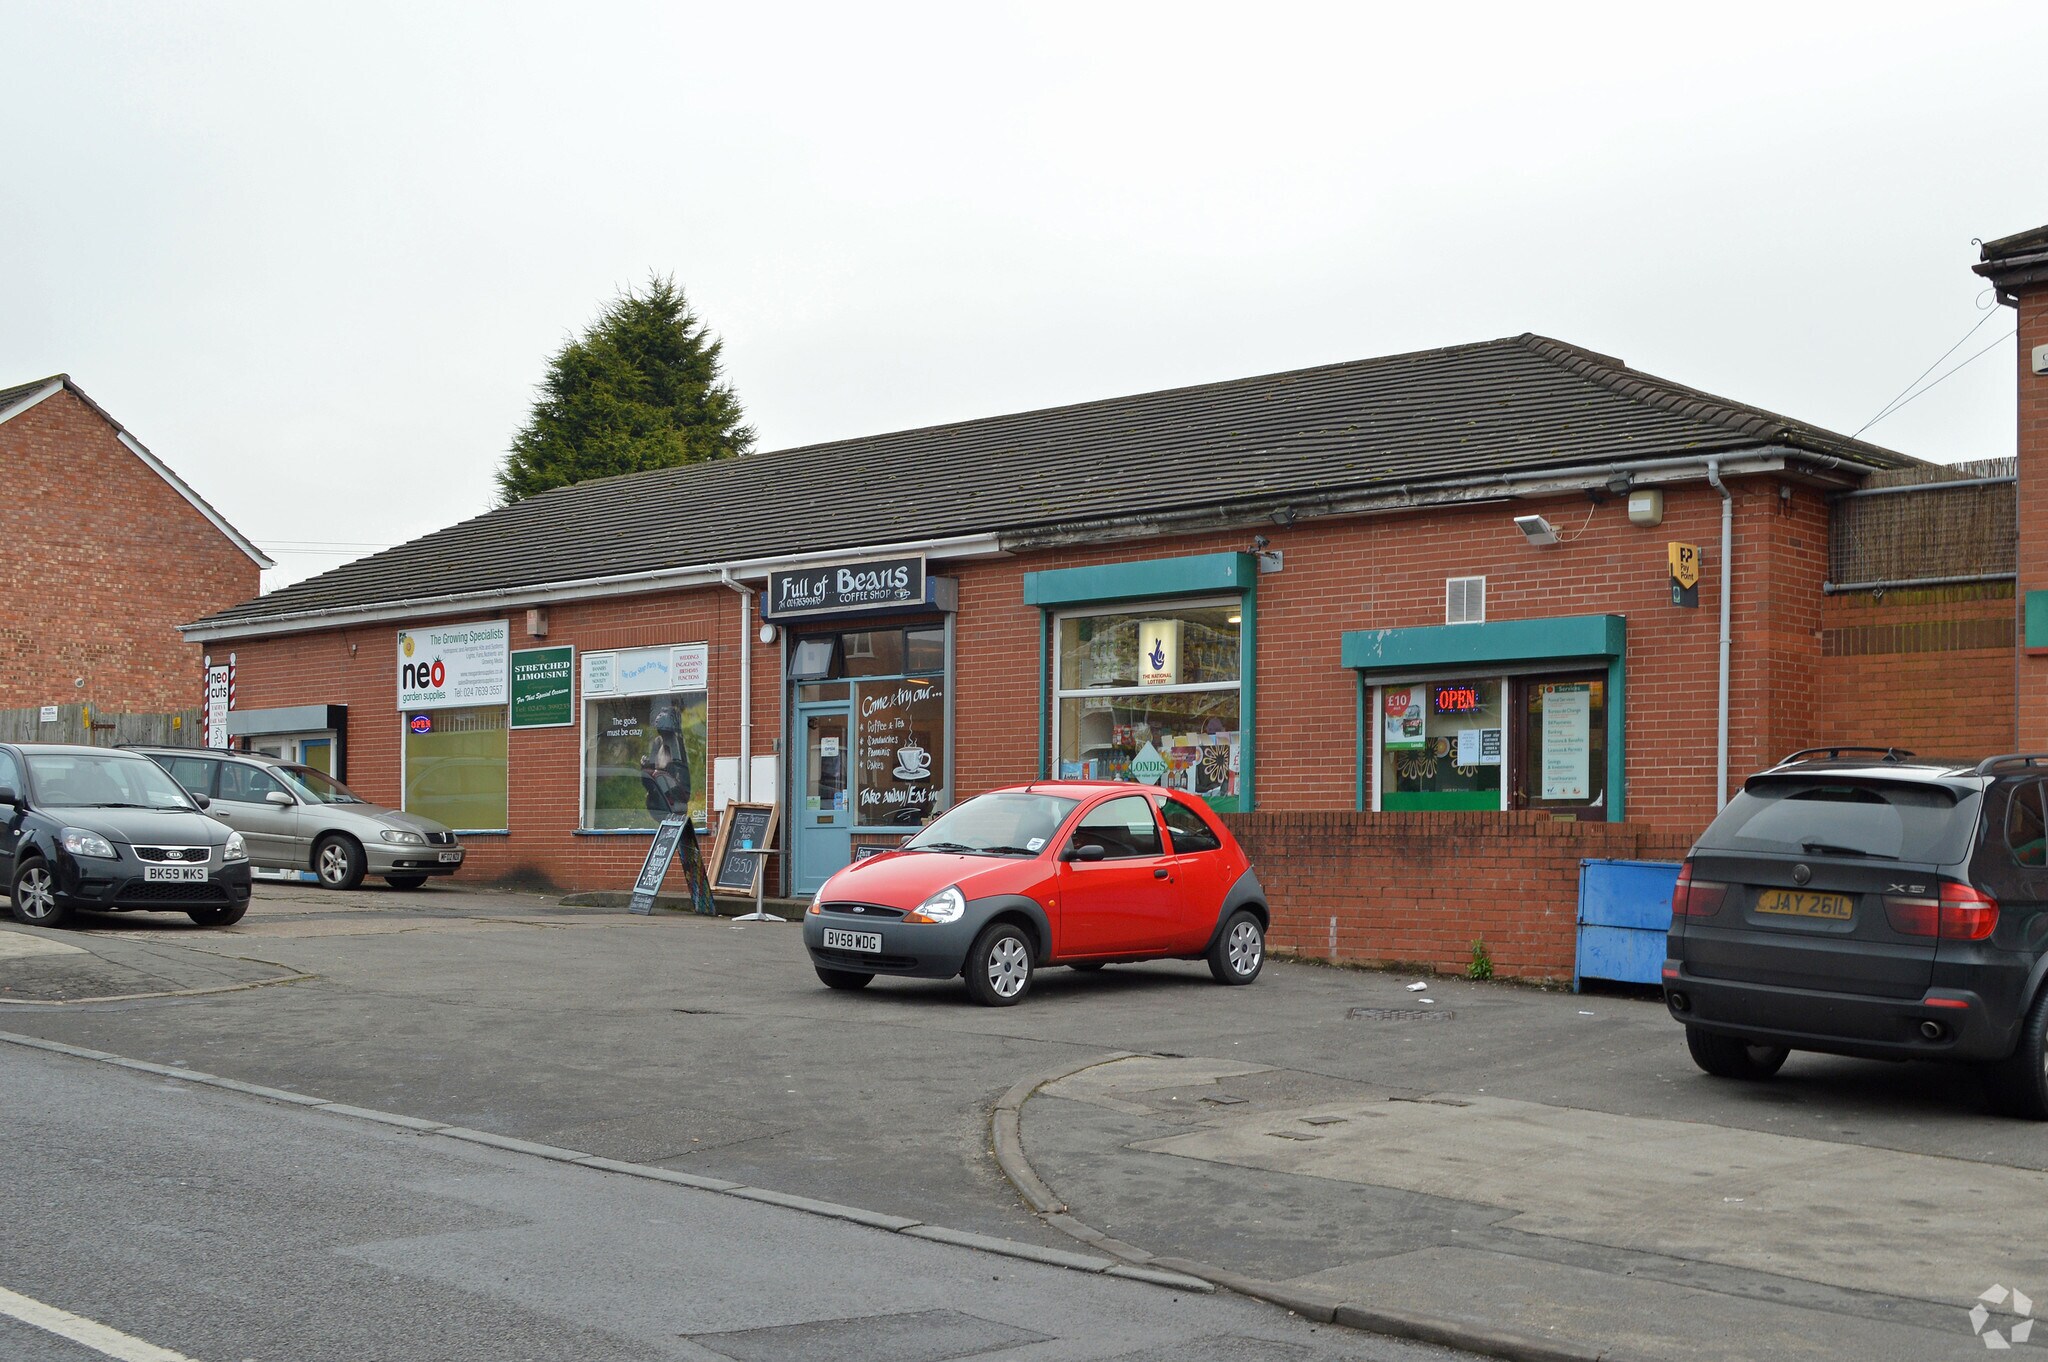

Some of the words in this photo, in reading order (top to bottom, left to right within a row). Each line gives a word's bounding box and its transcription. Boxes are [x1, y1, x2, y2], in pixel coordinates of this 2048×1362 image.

[1680, 562, 1689, 573] Pay
[1680, 572, 1694, 580] Point
[781, 576, 808, 601] Full
[836, 566, 909, 593] Beans
[839, 591, 868, 603] COFFEE
[870, 588, 891, 600] SHOP
[430, 634, 440, 645] The
[442, 632, 468, 645] Growing
[470, 628, 504, 644] Specialists
[514, 661, 570, 672] STRETCHED
[211, 672, 227, 684] neo
[403, 660, 446, 690] neo
[517, 670, 568, 681] LIMOUSINE
[211, 685, 227, 698] cuts
[402, 692, 422, 704] garden
[423, 690, 446, 702] supplies
[464, 688, 473, 697] 024
[475, 686, 488, 696] 7639
[536, 690, 552, 700] Special
[862, 695, 889, 717] Come
[896, 688, 912, 711] try
[1388, 695, 1406, 706] £10
[1440, 690, 1475, 709] OPEN
[411, 720, 430, 729] OPEN
[623, 717, 637, 727] gods
[867, 721, 887, 733] Coffee
[894, 718, 905, 728] Tea
[621, 728, 628, 736] be
[629, 729, 642, 737] crazy
[867, 735, 898, 747] Sandwiches
[867, 760, 884, 771] Cakes
[1131, 760, 1166, 772] LONDIS
[860, 787, 881, 806] Take
[928, 784, 938, 801] in
[150, 868, 180, 879] BK59
[183, 868, 204, 879] WKS
[1886, 884, 1926, 893] X5
[1770, 893, 1804, 911] JAY
[828, 932, 853, 947] BV58
[856, 934, 876, 950] WDG
